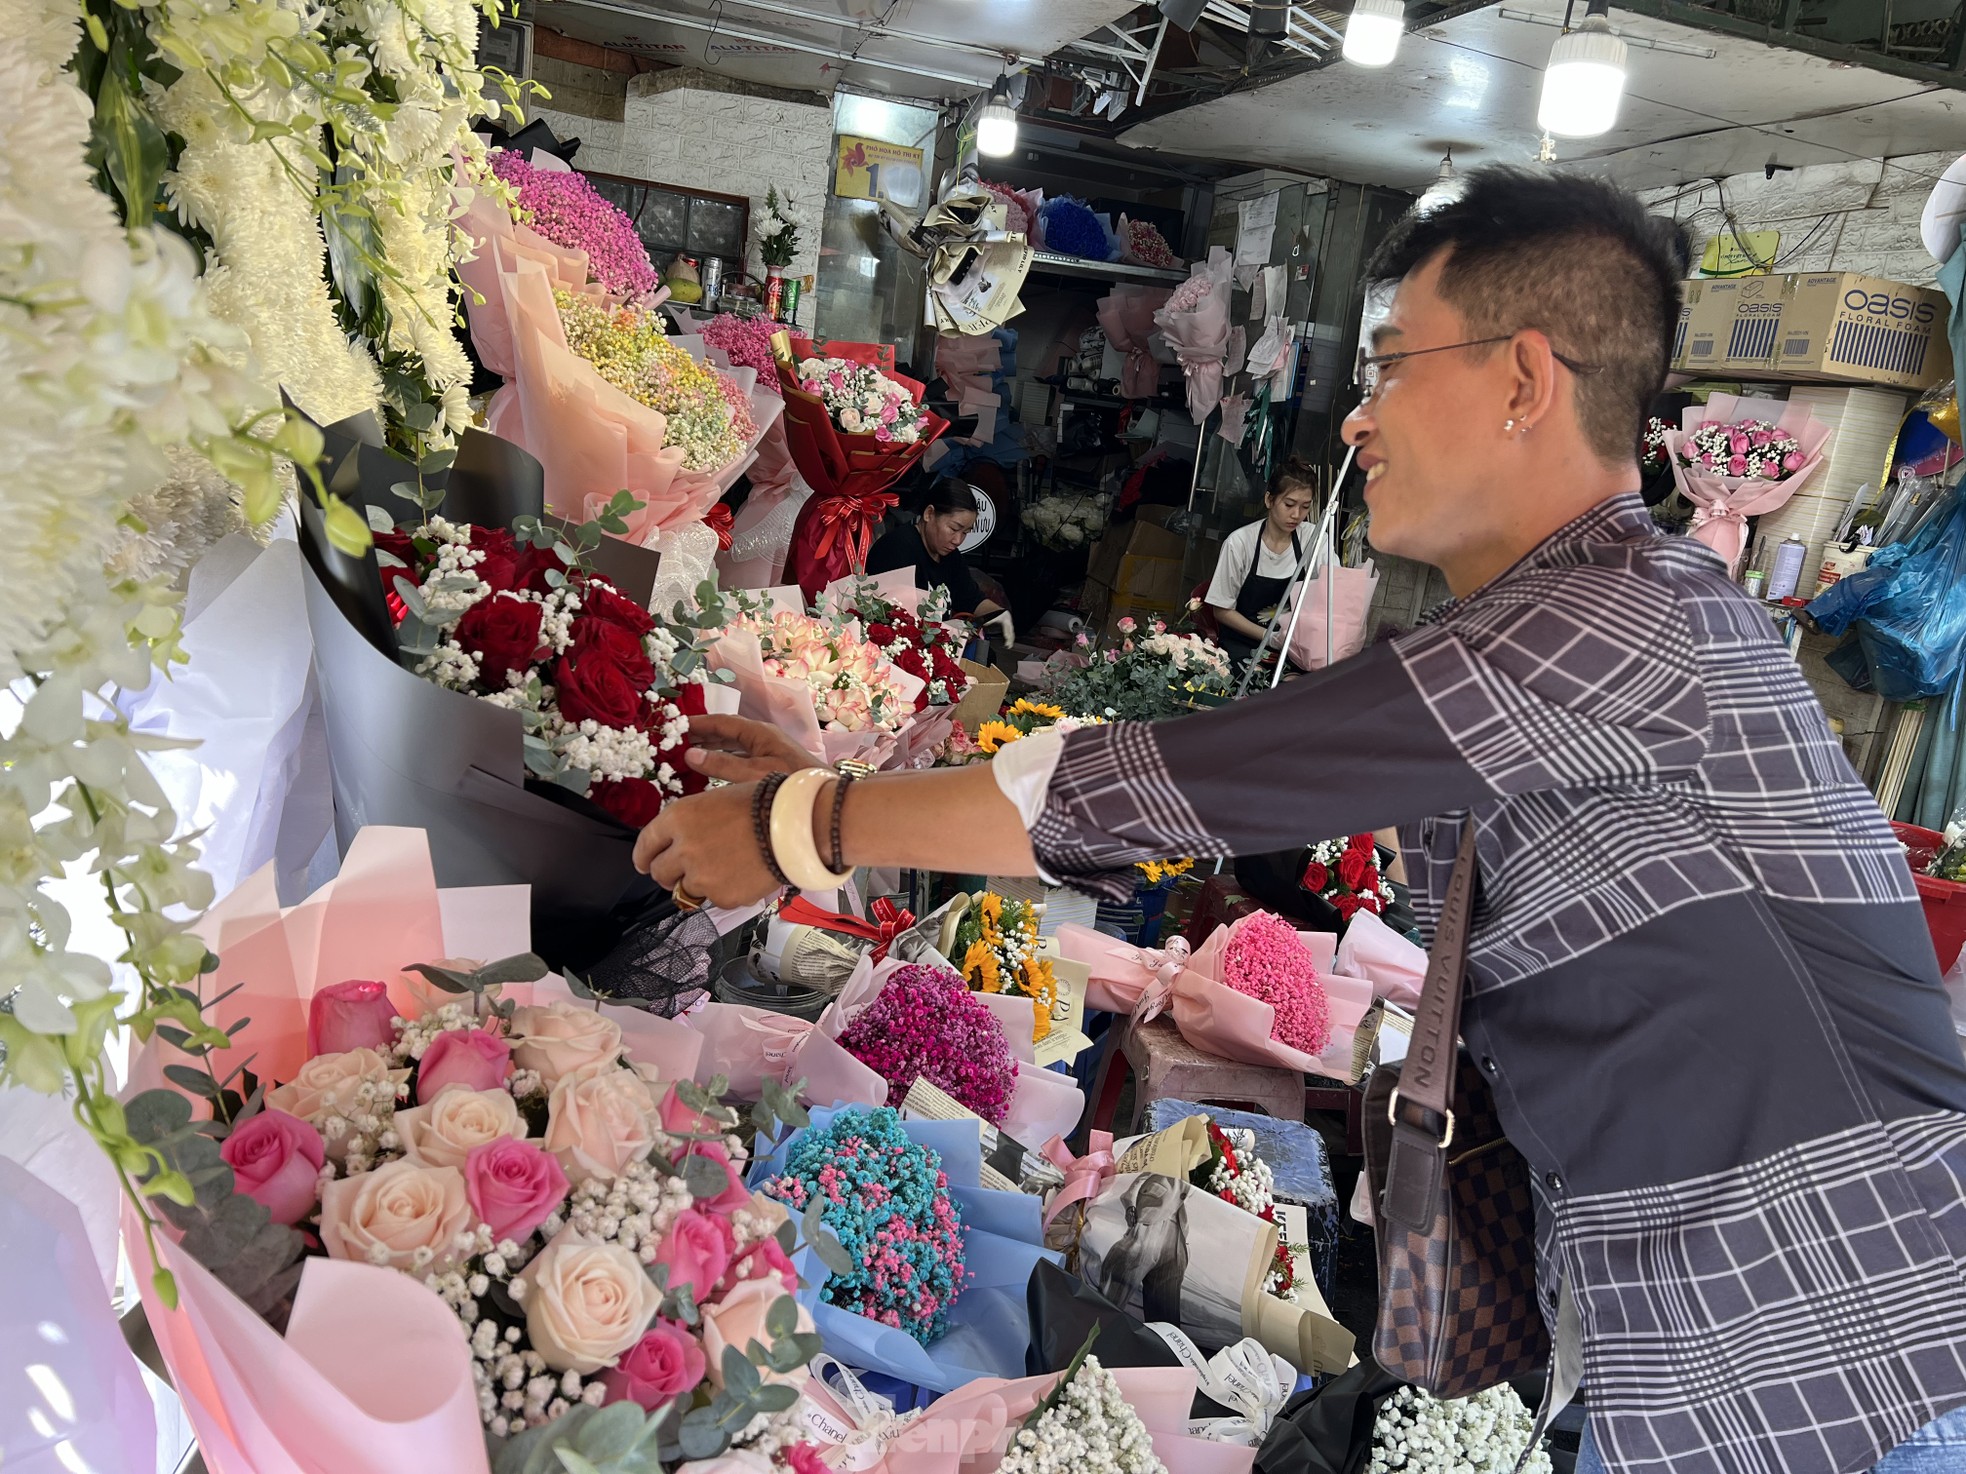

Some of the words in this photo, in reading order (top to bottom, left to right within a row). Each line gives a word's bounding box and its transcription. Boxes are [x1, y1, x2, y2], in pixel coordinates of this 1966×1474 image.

[1839, 311, 1890, 328] FLORAL
[1896, 321, 1932, 335] FOAM
[1413, 954, 1453, 1089] VUITTON
[1166, 1331, 1192, 1359] Chanel
[811, 1413, 848, 1444] Chanel
